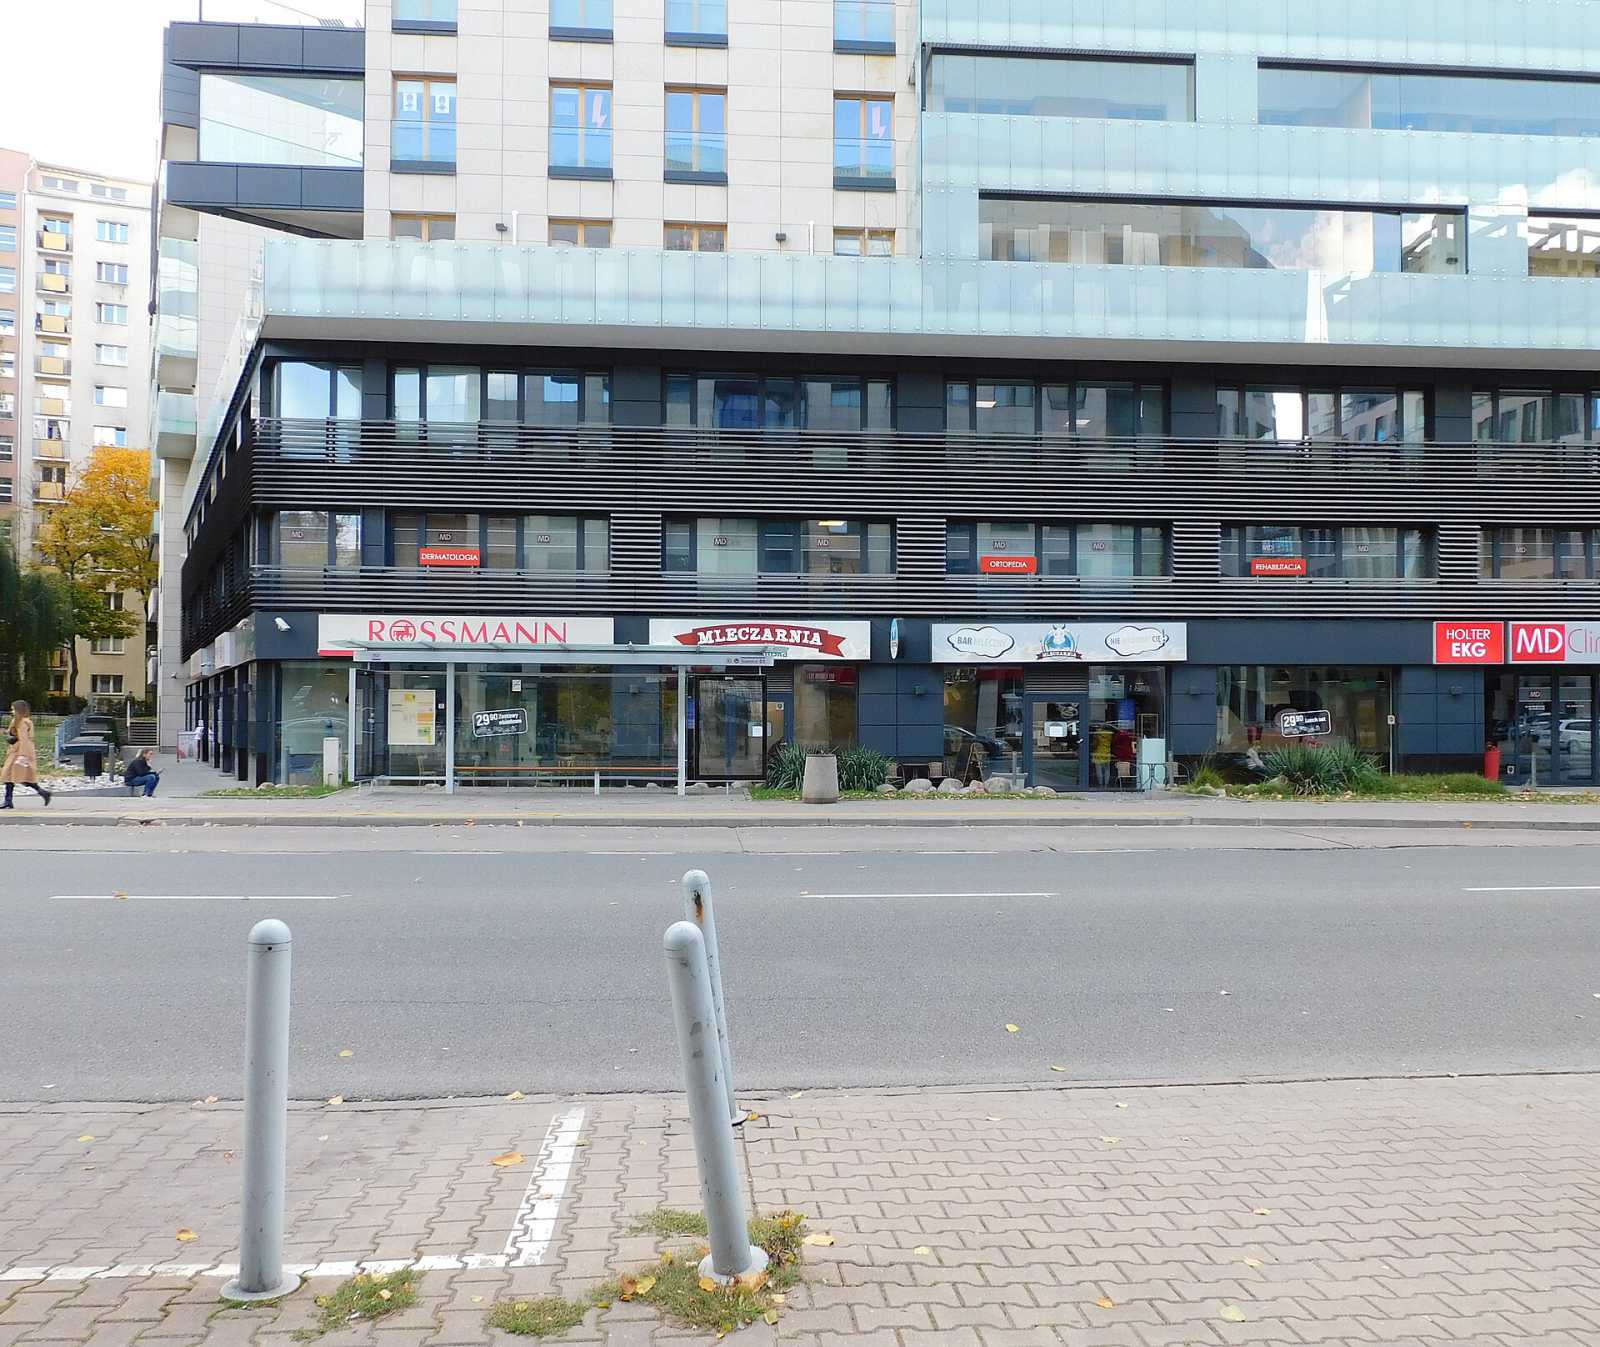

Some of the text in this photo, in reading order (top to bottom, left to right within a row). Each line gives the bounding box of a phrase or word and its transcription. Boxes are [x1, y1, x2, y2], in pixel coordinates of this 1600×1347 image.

[421, 553, 478, 561] DERMATOLOGIA
[989, 560, 1028, 569] ORTOPEDIA
[1255, 562, 1302, 571] REHABILITACJA
[368, 619, 567, 644] ROSSMANN
[696, 626, 823, 646] MLECZARNIA
[1446, 628, 1491, 640] HOLTER
[957, 636, 973, 646] BAR
[1516, 628, 1563, 653] MD
[1451, 642, 1487, 657] EKG
